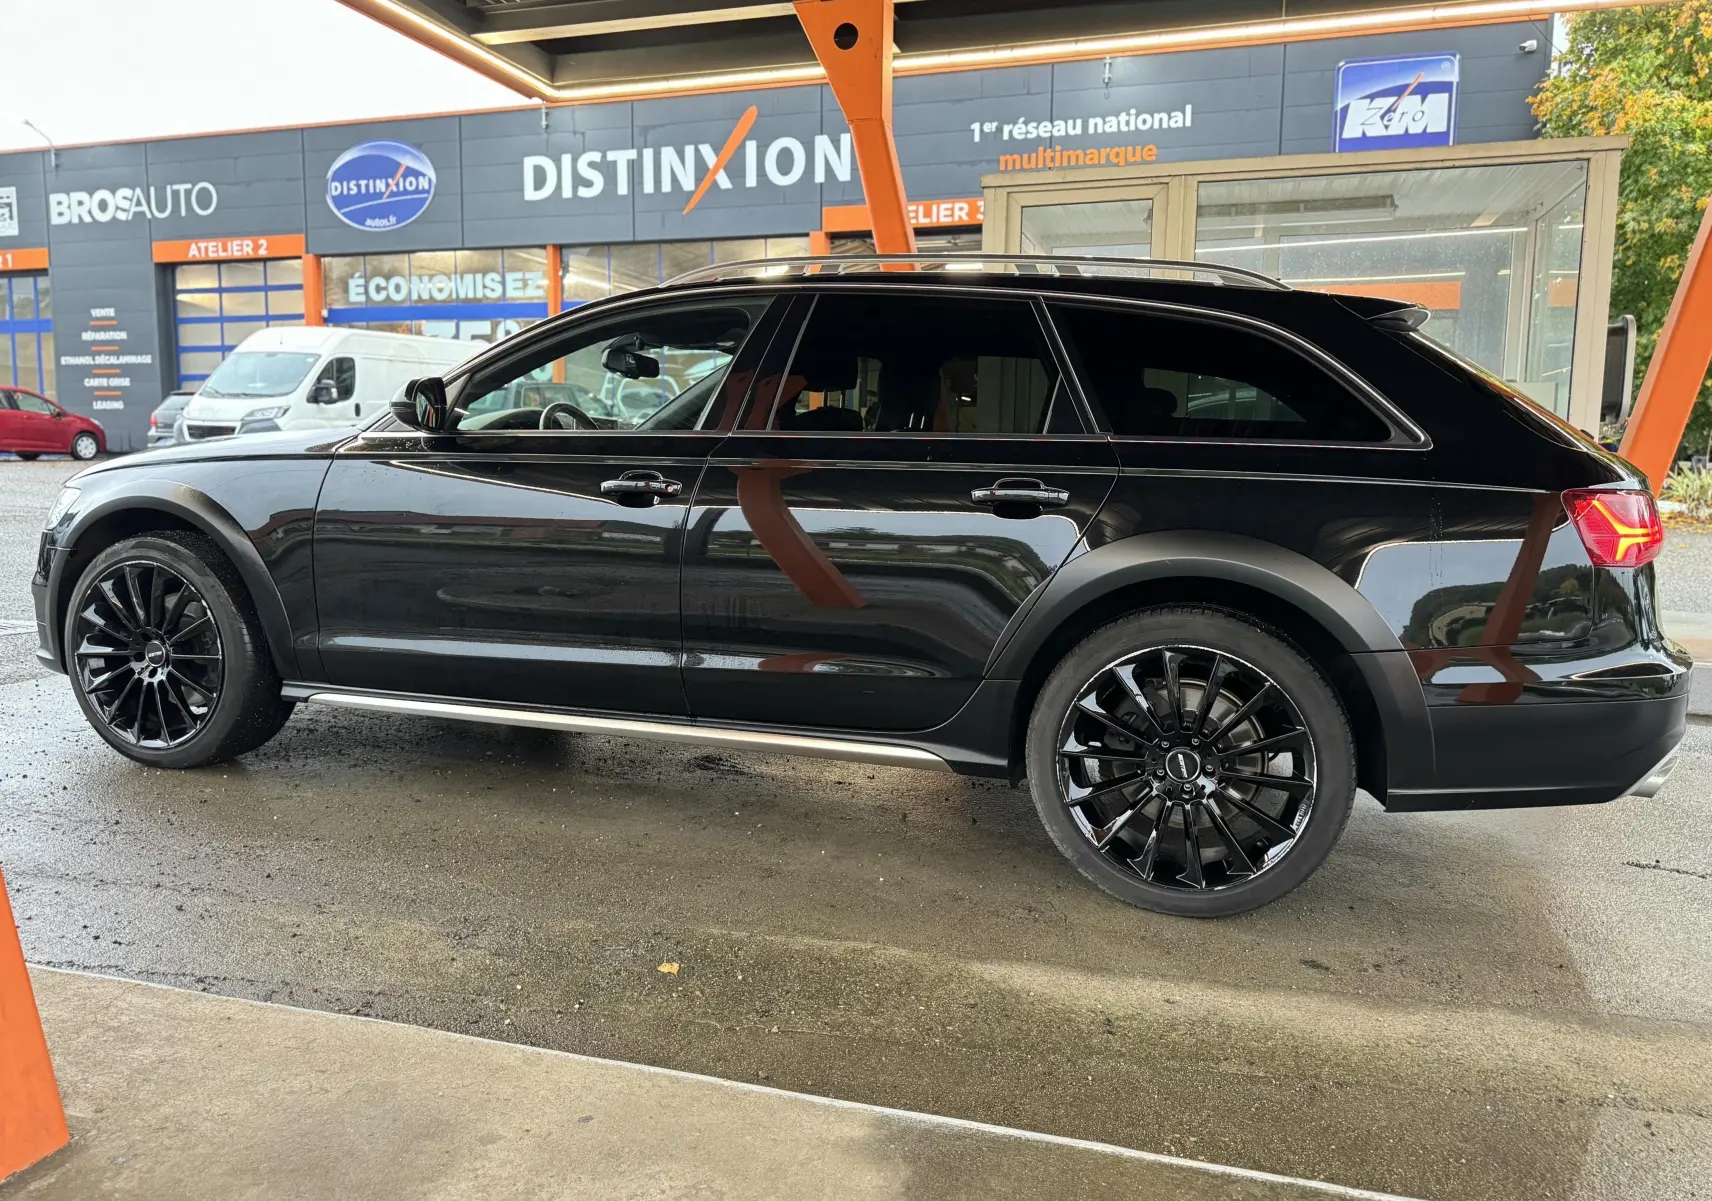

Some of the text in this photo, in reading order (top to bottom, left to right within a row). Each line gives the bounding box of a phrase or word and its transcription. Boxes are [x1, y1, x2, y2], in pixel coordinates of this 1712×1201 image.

[1002, 117, 1082, 141] réseau
[1088, 104, 1193, 134] national
[1360, 106, 1425, 126] Zero
[523, 113, 852, 212] DISTINXION
[999, 144, 1158, 172] multimarque
[331, 169, 430, 198] DISTINXION
[49, 181, 218, 226] BROSAUTO
[364, 215, 397, 228] autos.fr
[188, 239, 268, 259] ATELIER 2
[347, 271, 544, 303] ÉCONOMISEZ
[90, 307, 116, 318] VENTE
[81, 330, 128, 341] RÉPARATION
[60, 353, 152, 366] ETHANOL DÉCALAMINAGE
[83, 377, 131, 388] CARTE GRISE
[92, 400, 124, 410] LEASING
